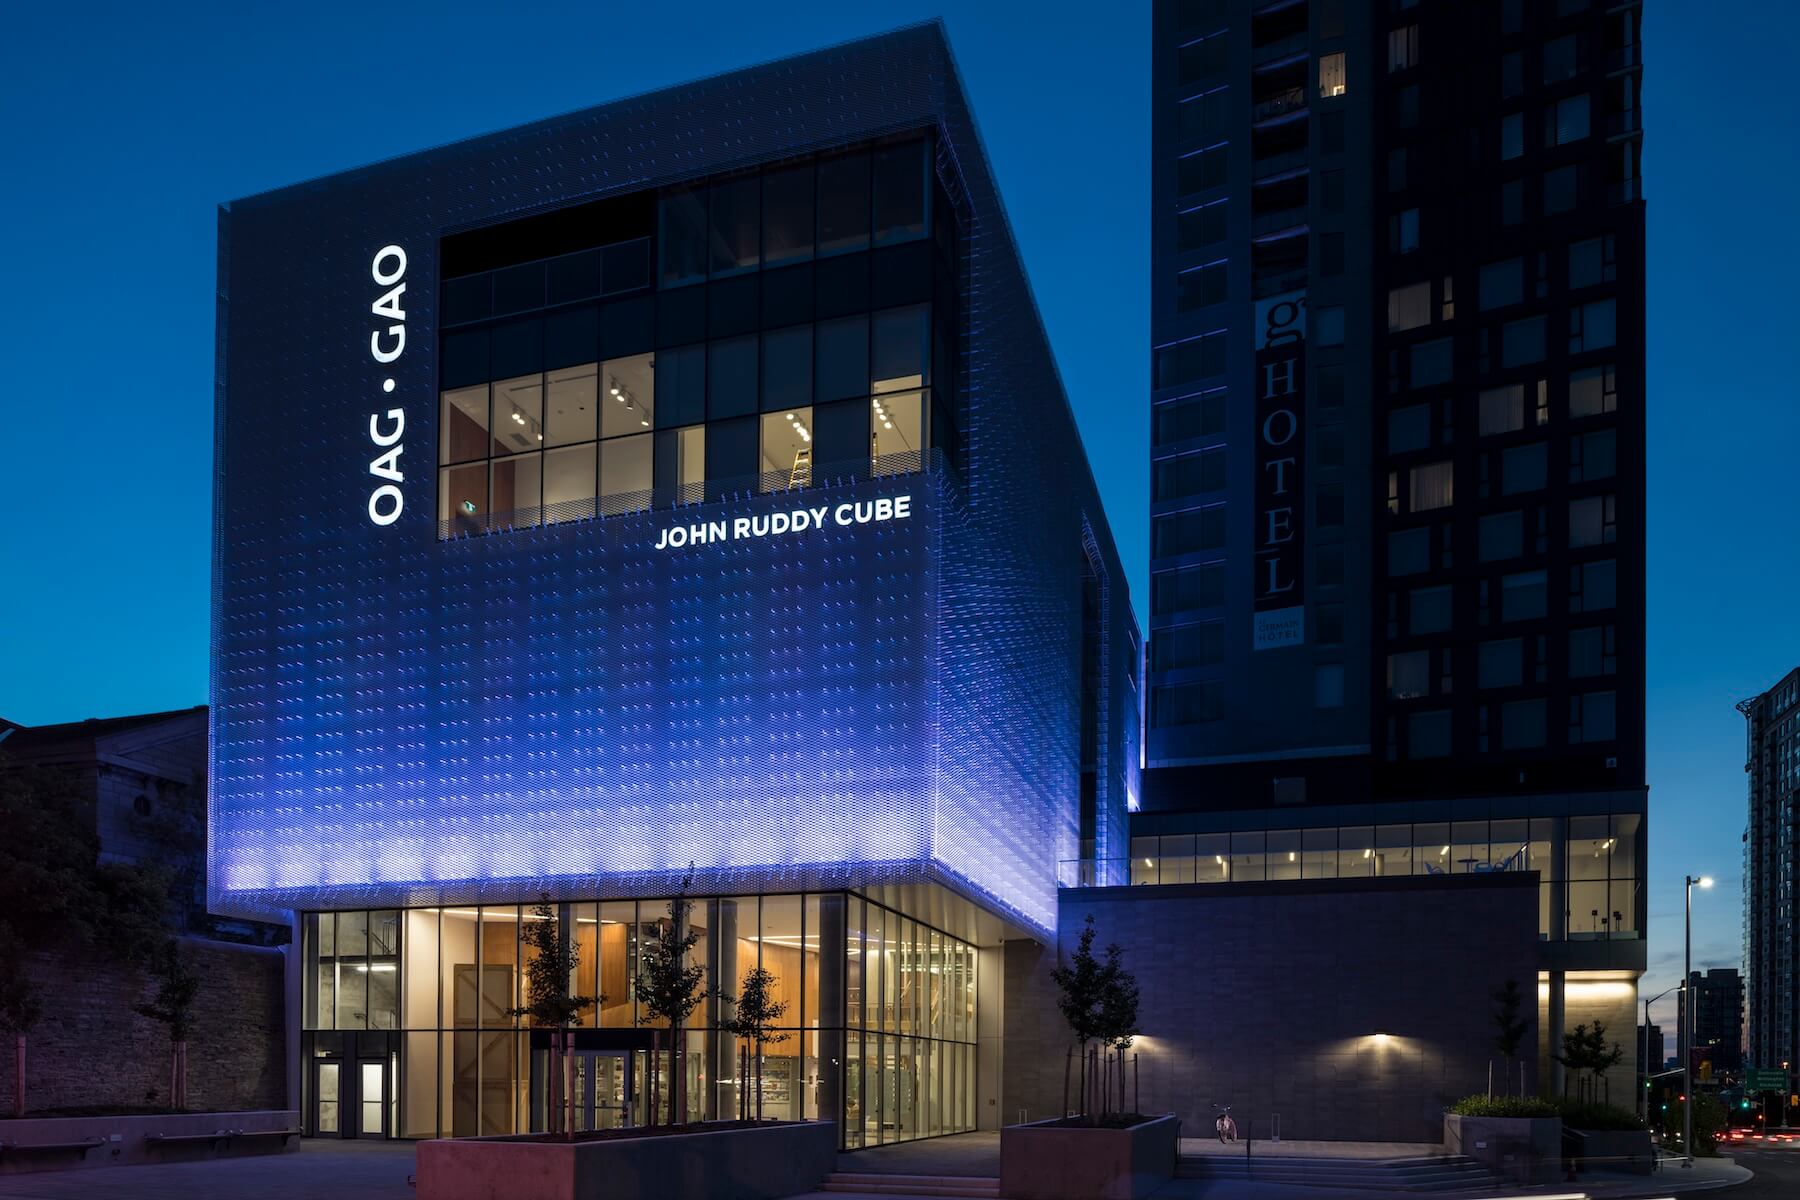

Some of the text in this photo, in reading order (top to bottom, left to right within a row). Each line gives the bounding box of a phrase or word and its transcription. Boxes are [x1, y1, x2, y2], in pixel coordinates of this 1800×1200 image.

[369, 245, 407, 526] OAG GAO
[1262, 357, 1298, 595] HOTEL
[655, 495, 911, 550] JOHN RUDDY CUBE
